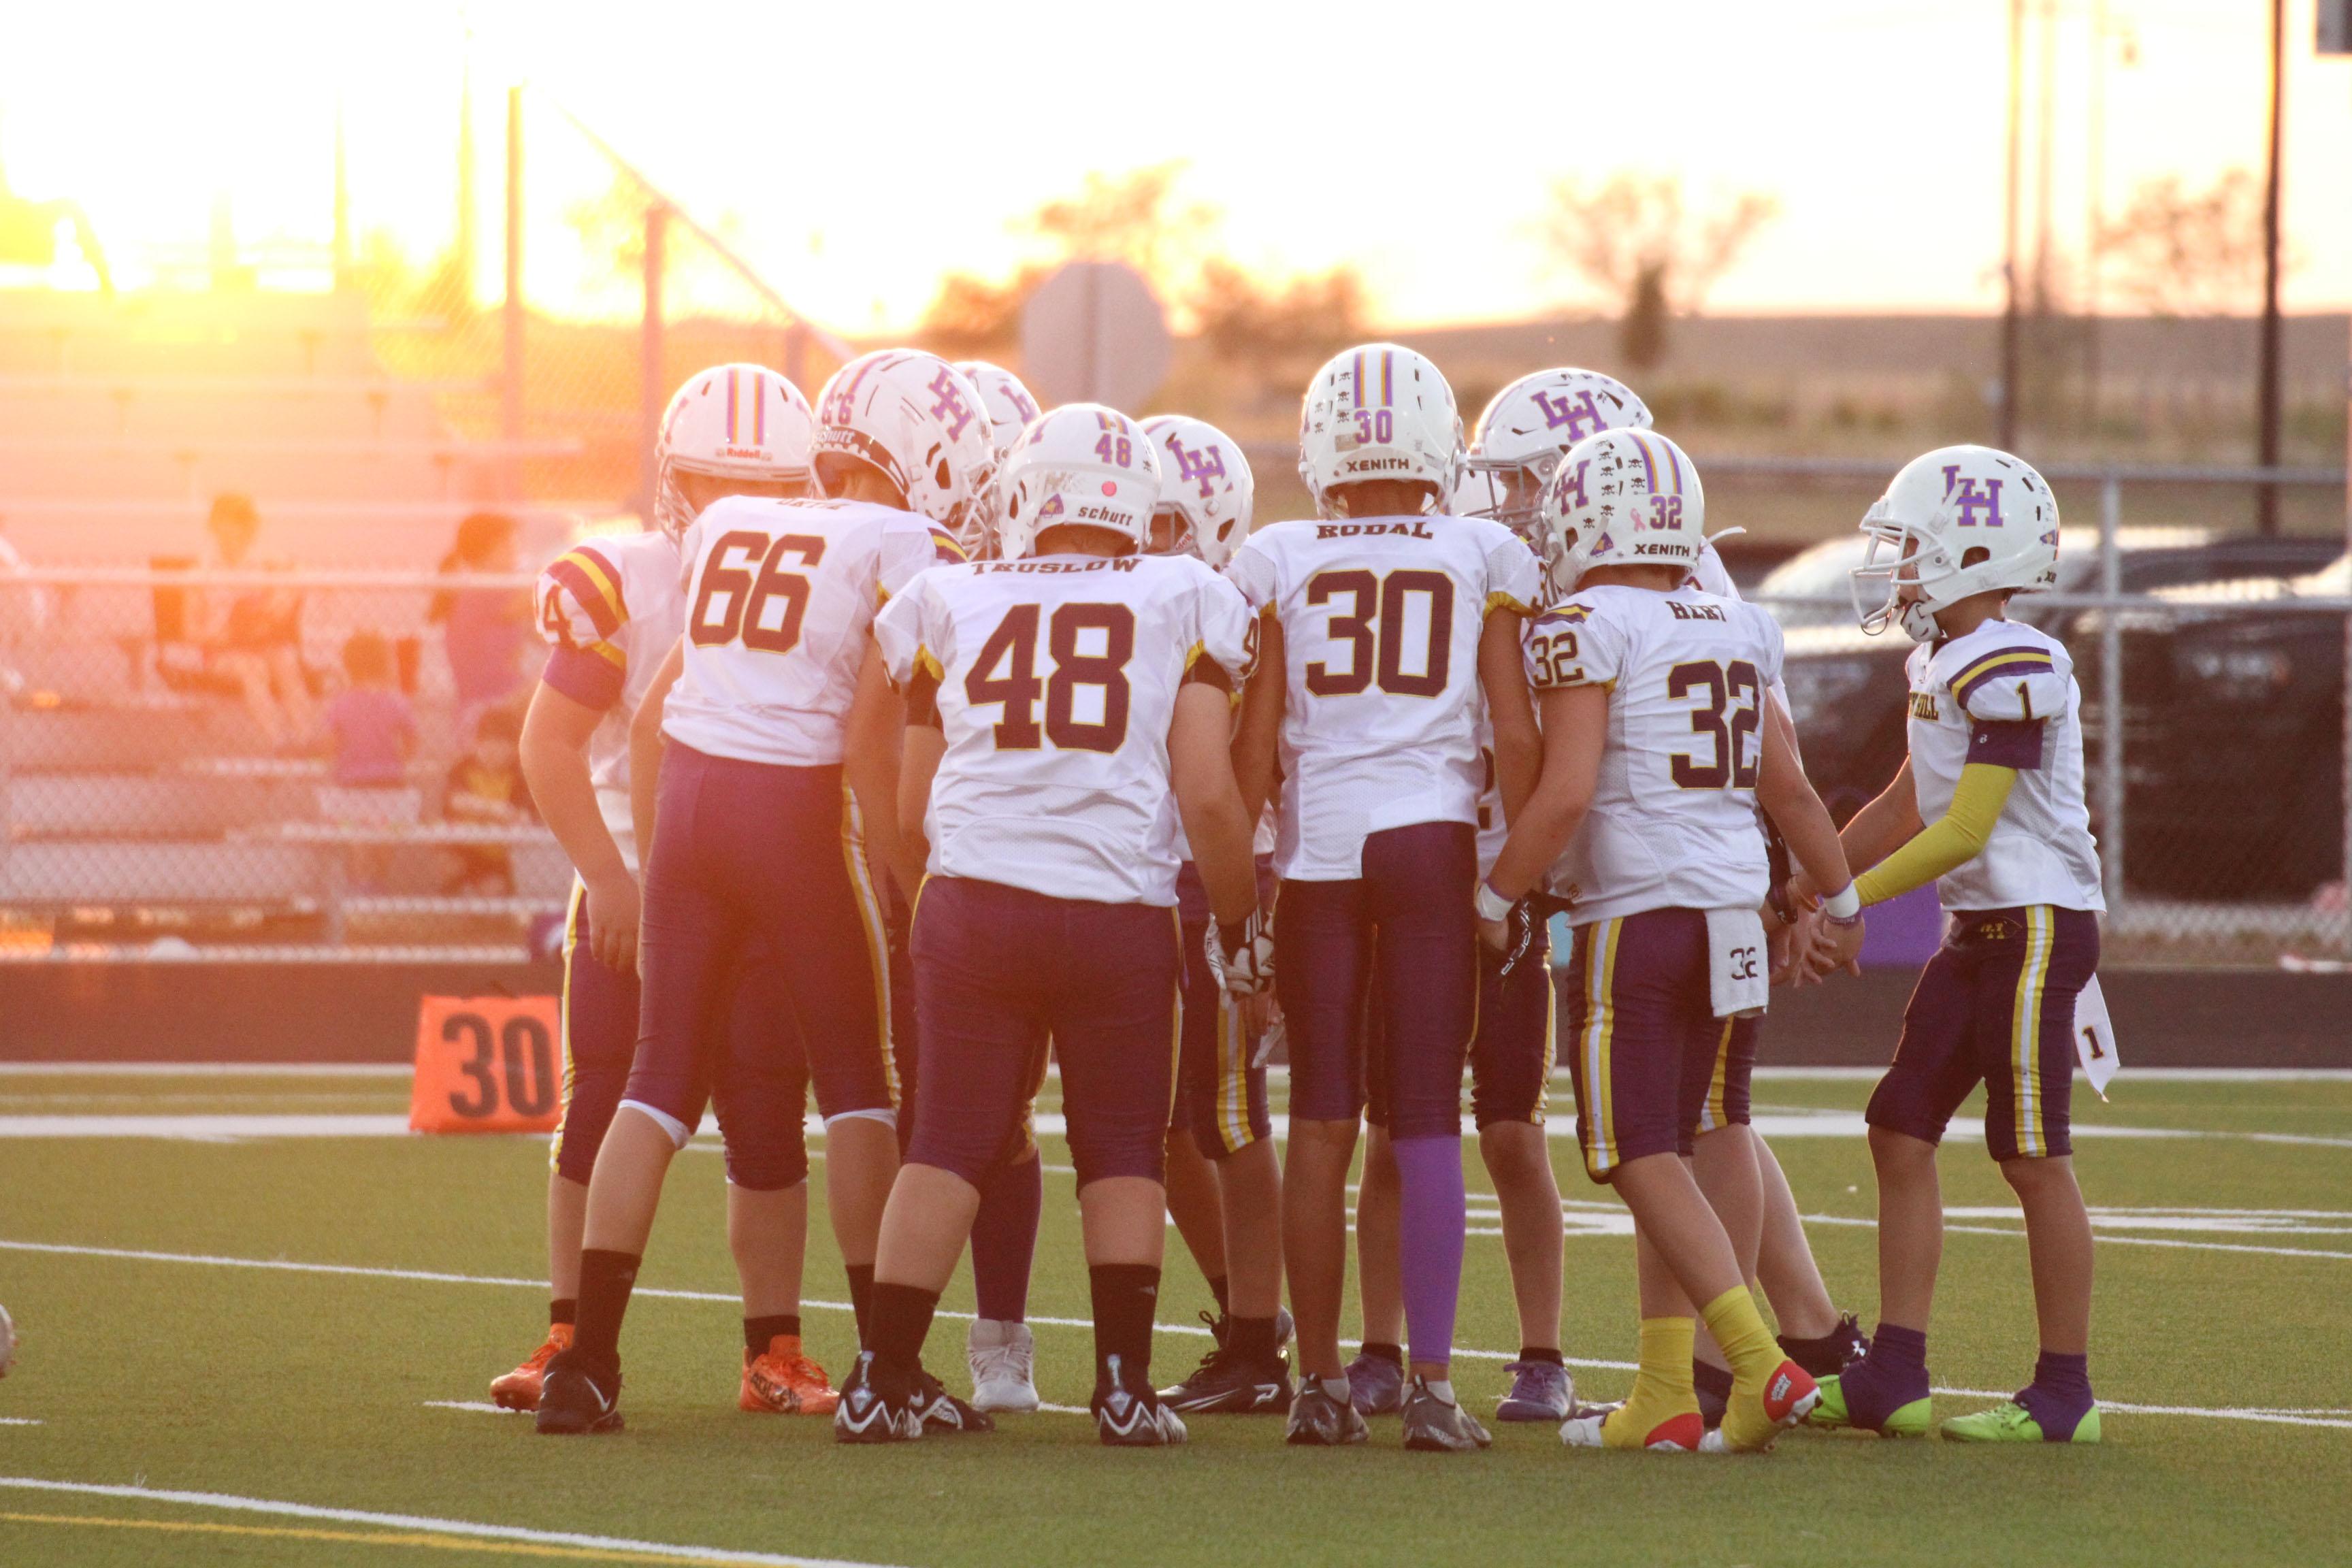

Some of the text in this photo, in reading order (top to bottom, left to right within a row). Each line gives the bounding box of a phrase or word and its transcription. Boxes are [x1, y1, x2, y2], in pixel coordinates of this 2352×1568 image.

[1354, 408, 1393, 444] 30
[1531, 389, 1610, 443] LH
[1094, 433, 1132, 469] 48
[1165, 438, 1226, 500] LH
[1346, 457, 1410, 473] XENITH
[1649, 495, 1683, 531] 32
[1942, 464, 2004, 528] LH
[1078, 506, 1134, 527] schutt
[1316, 522, 1434, 540] RODAL
[970, 557, 1143, 576] TRUSLOW
[1634, 543, 1691, 558] XENITH
[689, 530, 827, 655] 66
[1305, 569, 1456, 699] 30
[964, 602, 1137, 756] 48
[1531, 632, 1585, 687] 32
[2016, 680, 2034, 720] 1
[1666, 658, 1761, 791] 32
[2082, 1026, 2104, 1060] 1
[441, 1011, 558, 1119] 30
